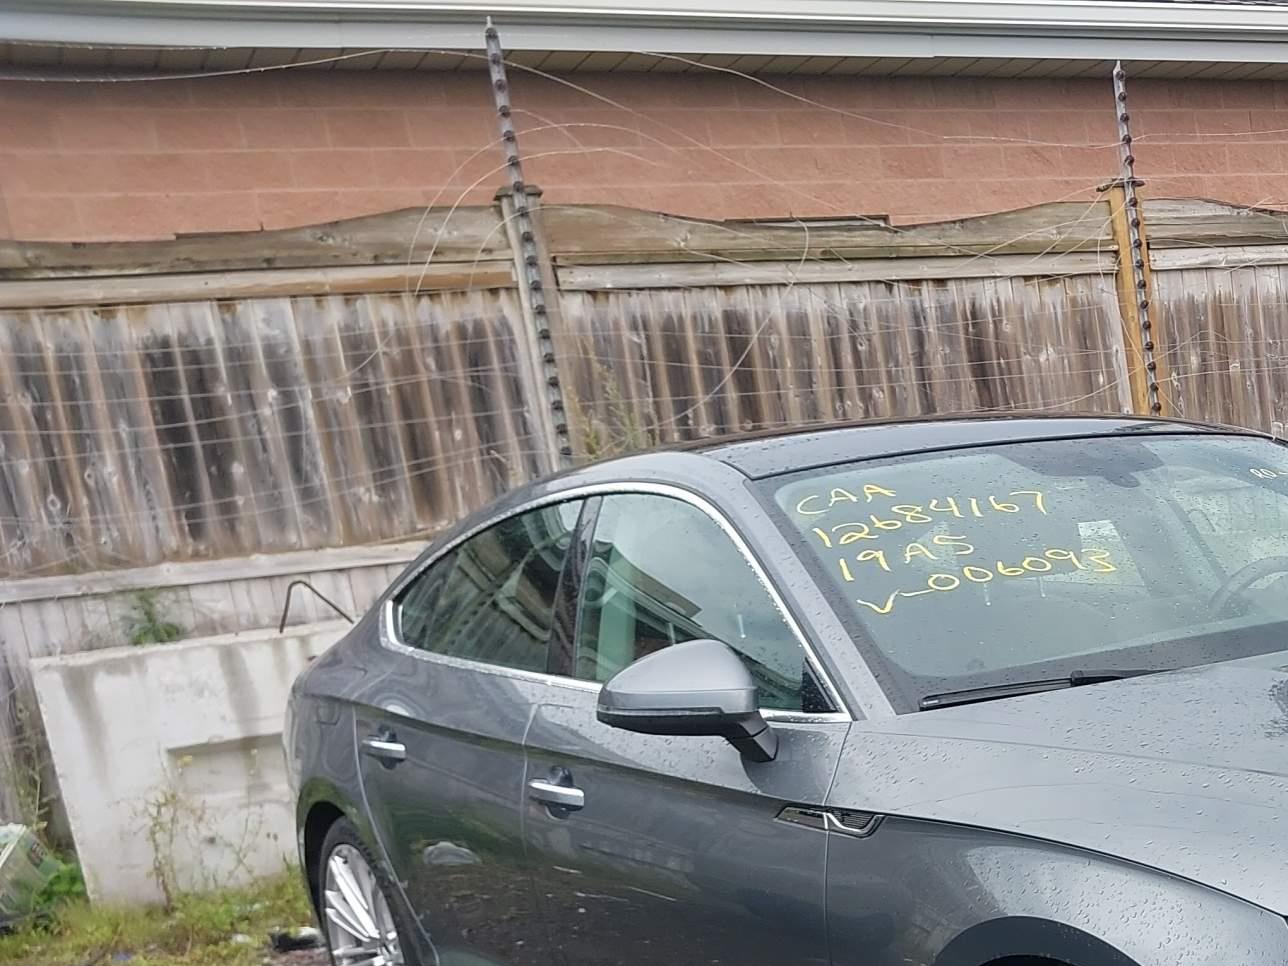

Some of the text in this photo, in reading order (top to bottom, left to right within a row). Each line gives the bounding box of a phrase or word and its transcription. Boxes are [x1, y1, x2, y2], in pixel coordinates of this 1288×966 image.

[796, 484, 897, 515] CAA
[812, 490, 1048, 548] 12684167
[838, 549, 892, 582] 19
